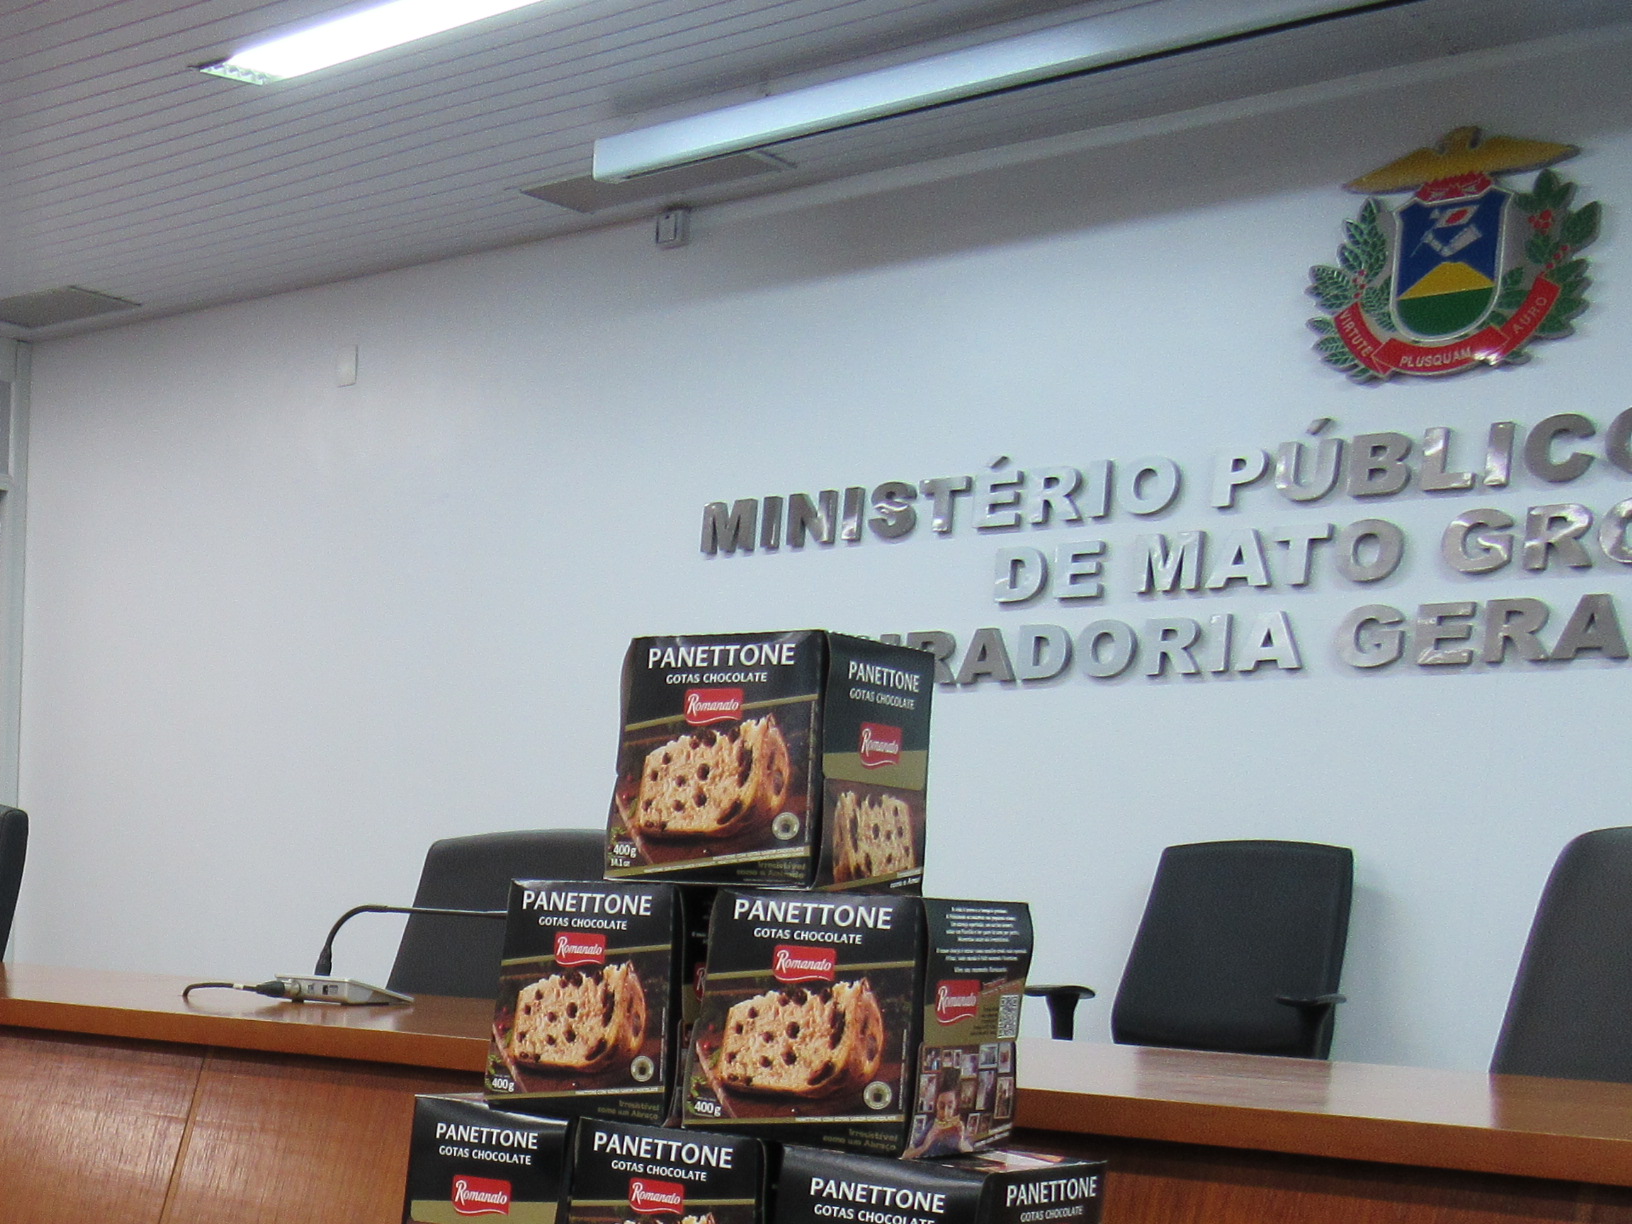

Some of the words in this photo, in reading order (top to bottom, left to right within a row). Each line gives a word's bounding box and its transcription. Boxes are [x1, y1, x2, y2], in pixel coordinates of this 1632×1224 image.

[1340, 310, 1373, 358] VIRTUTE
[1514, 297, 1548, 334] AURO
[702, 456, 1181, 556] MINISTÉRIO
[994, 540, 1105, 604] DE
[1133, 519, 1403, 595] MATO
[648, 644, 796, 669] PANETTONE
[666, 673, 700, 684] GOTAS
[703, 672, 768, 683] CHOCOLATE
[848, 661, 920, 692] PANETTONE
[686, 694, 739, 716] Romanato
[849, 688, 875, 702] GOTAS
[876, 691, 915, 711] CHOCOLATE
[861, 728, 899, 757] Romanato
[521, 890, 653, 917] PANETTONE
[733, 900, 893, 931] PANETTONE
[538, 916, 569, 929] GOTAS
[571, 917, 628, 932] CHOCOLATE
[753, 927, 791, 940] GOTAS
[793, 930, 863, 946] CHOCOLATE
[556, 934, 604, 961] Romanato
[776, 949, 833, 978] Romanato
[435, 1122, 539, 1150] PANETTONE
[439, 1145, 469, 1158] GOTAS
[472, 1149, 532, 1166] CHOCOLATE
[593, 1132, 734, 1169] PANETTONE
[611, 1159, 644, 1174] GOTAS
[646, 1166, 707, 1182] CHOCOLATE
[455, 1180, 508, 1206] Romanato
[631, 1182, 680, 1205] Romanato
[810, 1177, 946, 1214] PANETTONE
[1006, 1176, 1097, 1207] PANETTONE
[814, 1203, 854, 1220] GOTAS
